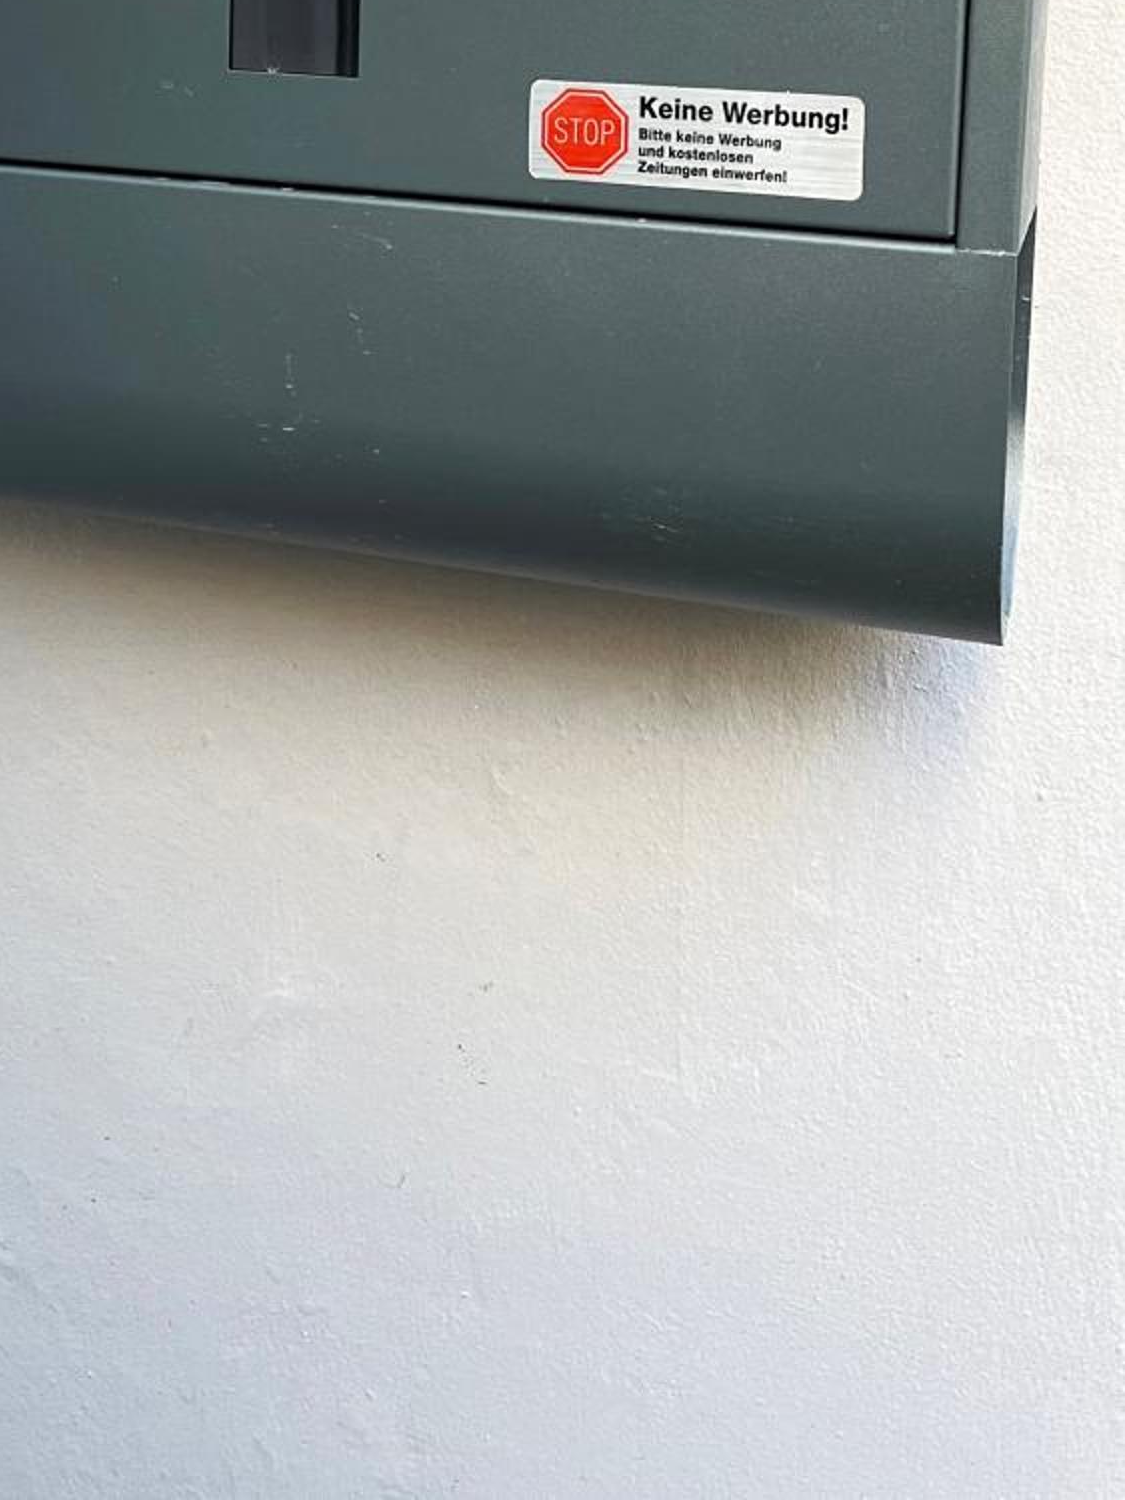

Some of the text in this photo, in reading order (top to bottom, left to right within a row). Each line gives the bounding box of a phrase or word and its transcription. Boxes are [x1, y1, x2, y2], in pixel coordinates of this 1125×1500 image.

[638, 96, 849, 134] Keine Werbung!
[553, 117, 616, 147] STOP
[638, 128, 781, 151] Bitte keine Werbung
[638, 146, 753, 164] und kostenlosen
[637, 161, 788, 183] Zeitungen einwerfen!
